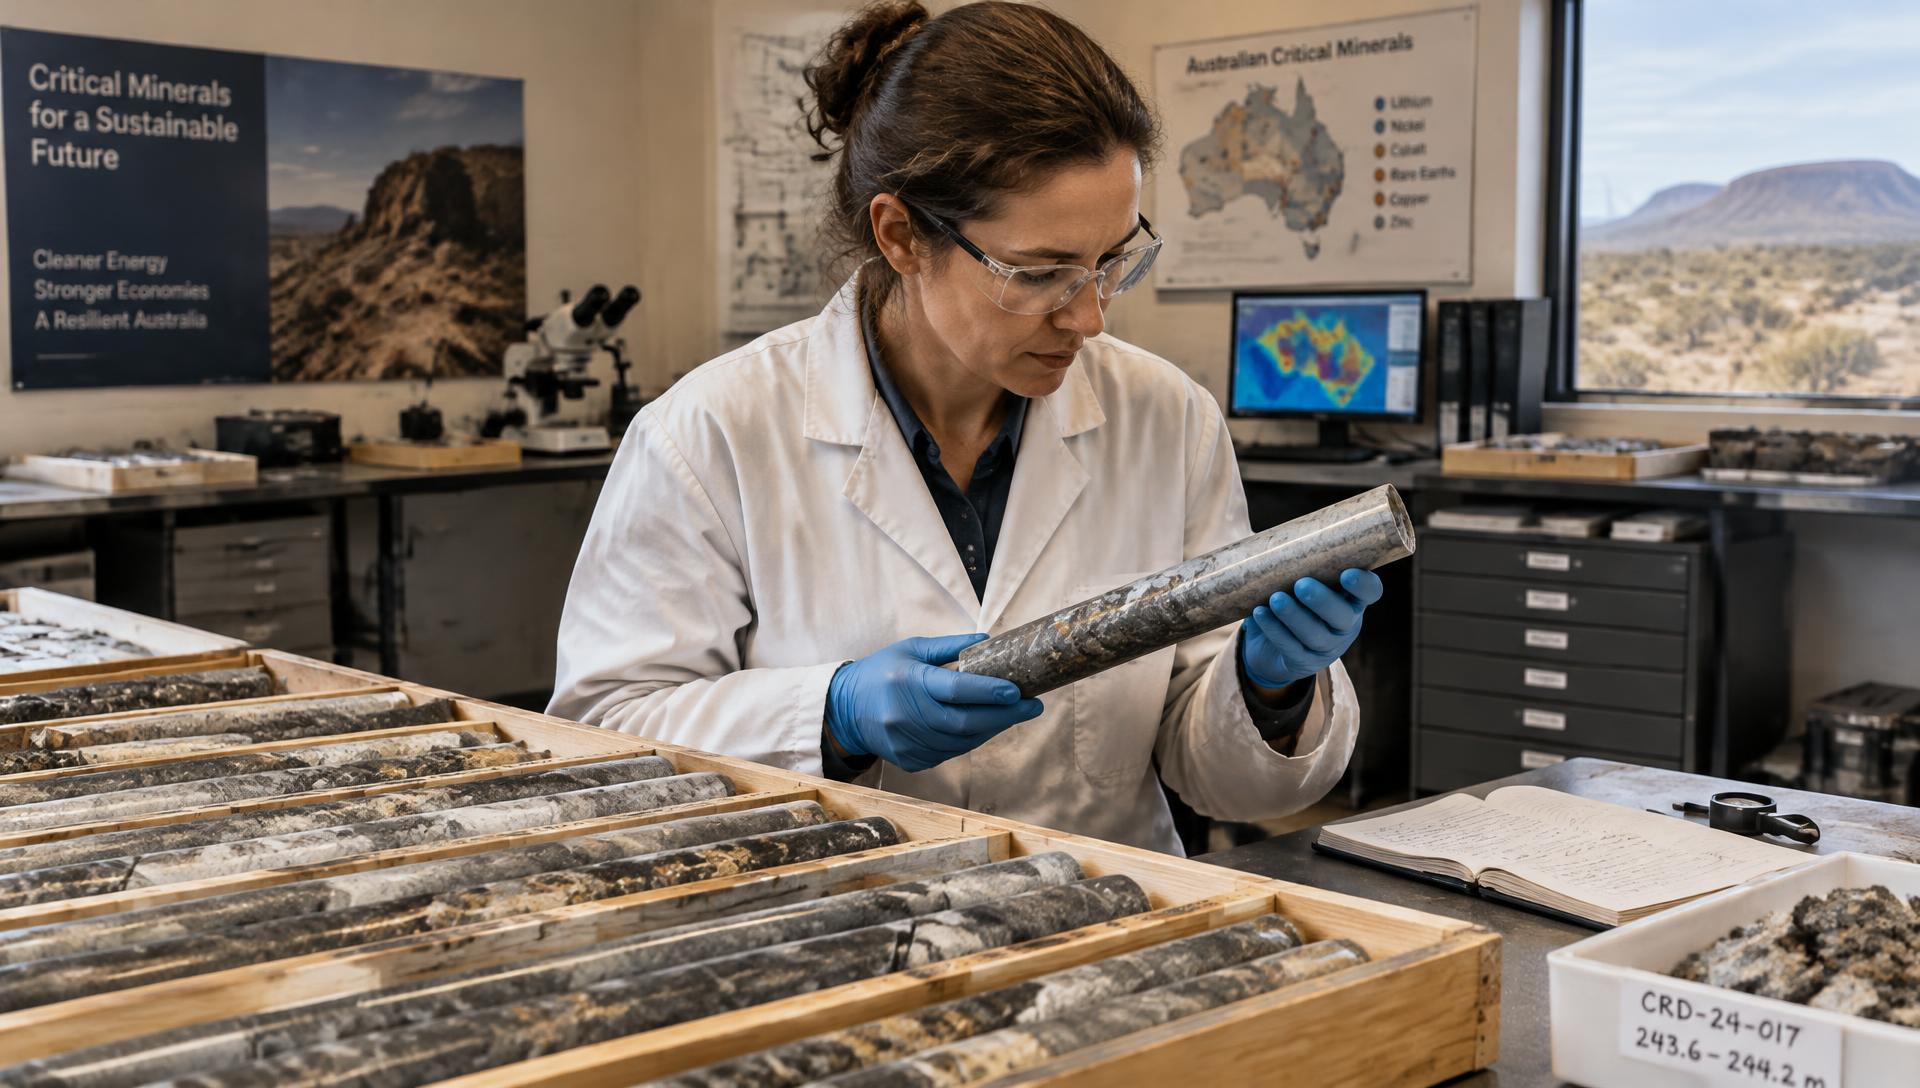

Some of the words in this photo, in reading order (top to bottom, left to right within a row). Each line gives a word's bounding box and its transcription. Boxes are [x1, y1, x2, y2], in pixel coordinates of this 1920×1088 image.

[1186, 50, 1268, 74] Australian
[1271, 43, 1332, 66] Critical
[1337, 33, 1414, 58] Minerals
[28, 63, 121, 98] Critical
[128, 72, 232, 107] Minerals
[29, 100, 66, 130] for
[74, 111, 89, 132] a
[96, 106, 238, 142] Sustainable
[31, 138, 120, 170] Future
[33, 249, 102, 270] Cleaner
[107, 250, 168, 276] Energy
[34, 279, 113, 303] Stronger
[118, 280, 210, 300] Economies
[35, 312, 50, 330] A
[54, 310, 130, 330] Resilient
[134, 310, 207, 330] Australia
[1641, 990, 1802, 1048] CRD-24-017
